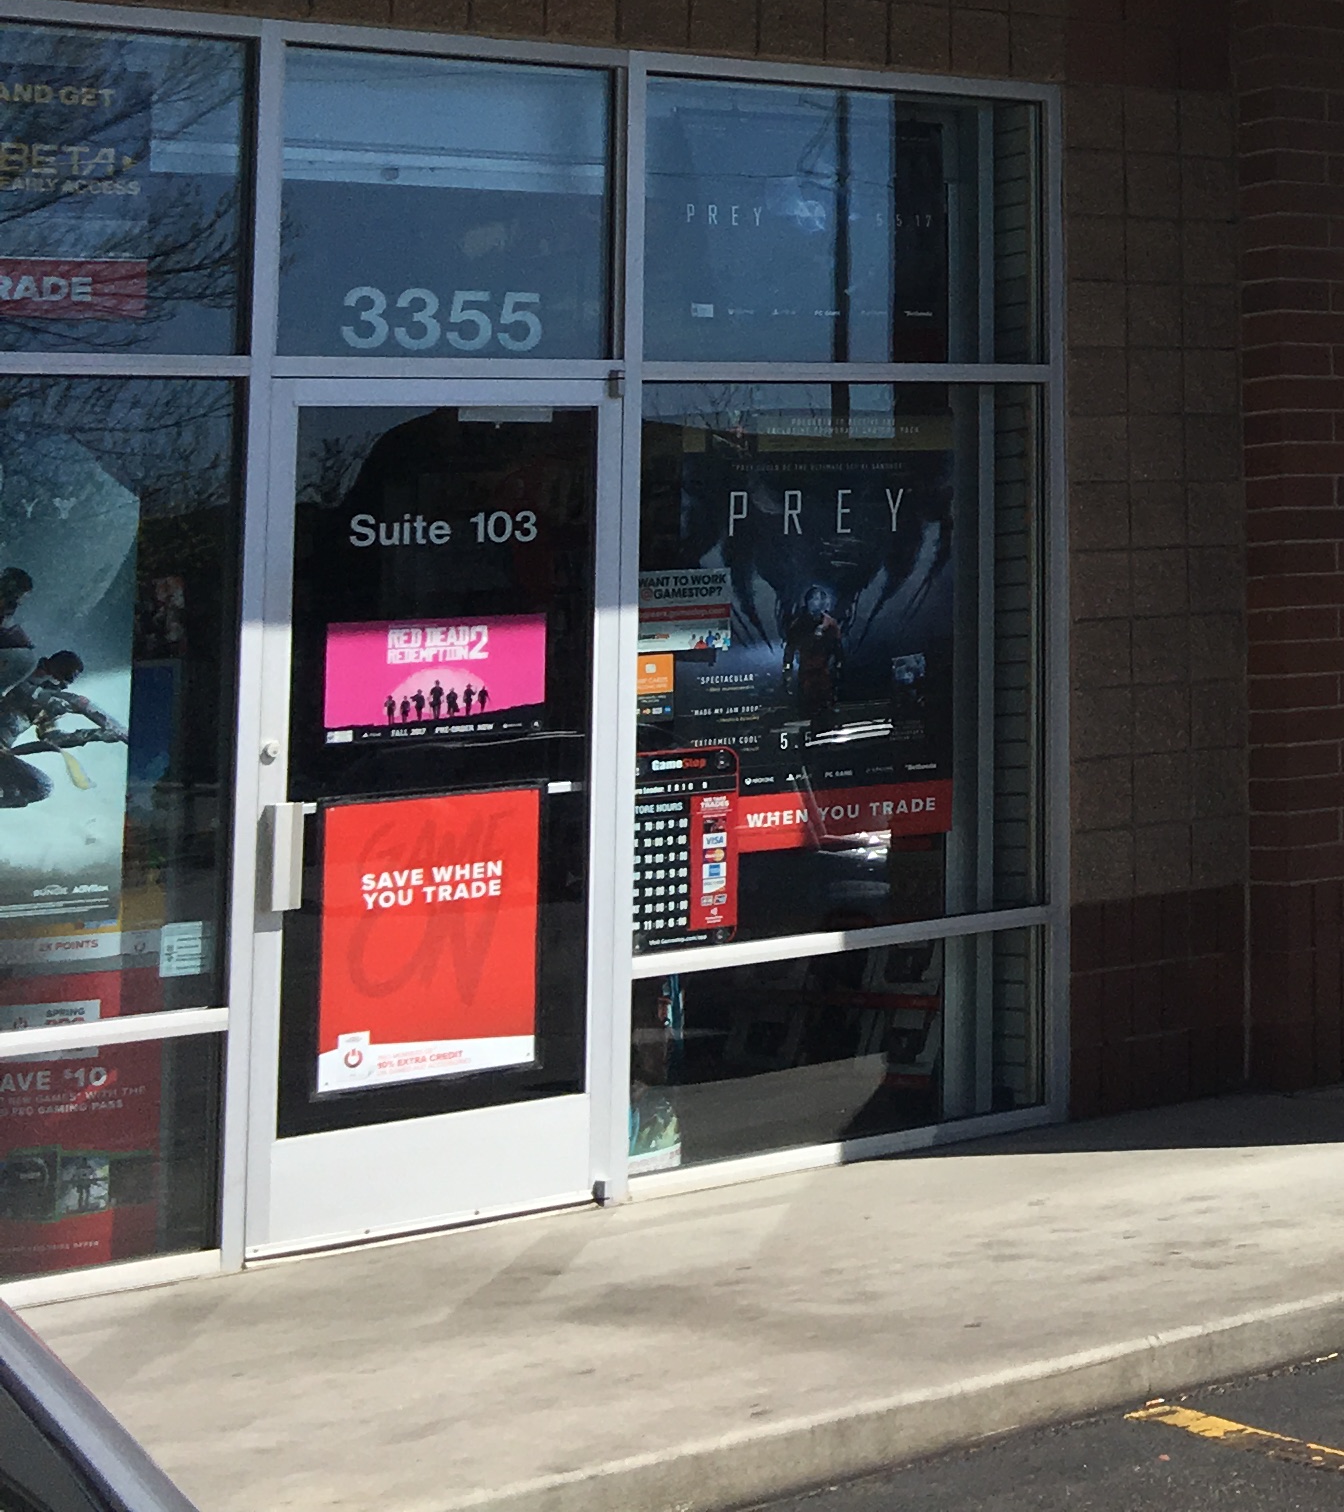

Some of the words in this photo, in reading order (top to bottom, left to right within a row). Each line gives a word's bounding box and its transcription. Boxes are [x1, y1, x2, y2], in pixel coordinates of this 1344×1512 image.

[57, 88, 117, 108] GET
[686, 203, 763, 227] PREY
[339, 285, 543, 353] 3355
[728, 488, 904, 537] PREY
[348, 512, 452, 548] Suite
[470, 510, 538, 544] 103
[672, 575, 689, 586] TO
[690, 573, 727, 585] WORK
[640, 586, 723, 602] @GAMESTOP?
[387, 627, 423, 649] RED
[424, 625, 469, 648] DEAD
[469, 624, 489, 660] 2
[387, 645, 469, 664] REDEMPTION
[390, 728, 409, 738] FALL
[651, 757, 707, 772] GameStop
[655, 801, 684, 813] HOURS
[746, 809, 809, 828] WHEN
[818, 804, 860, 821] YOU
[869, 797, 936, 816] TRADE
[705, 835, 724, 846] VISA
[361, 867, 424, 892] SAVE
[431, 859, 504, 884] WHEN
[362, 888, 414, 910] YOU
[421, 878, 502, 904] TRADE
[54, 939, 99, 951] POINTS
[46, 1007, 86, 1018] SPRING
[397, 1055, 428, 1066] EXTRA
[429, 1050, 464, 1062] CREDIT
[63, 1066, 108, 1088] $10
[85, 1088, 118, 1101] WITH
[37, 1102, 87, 1115] GAMING
[91, 1099, 124, 1110] PASS
